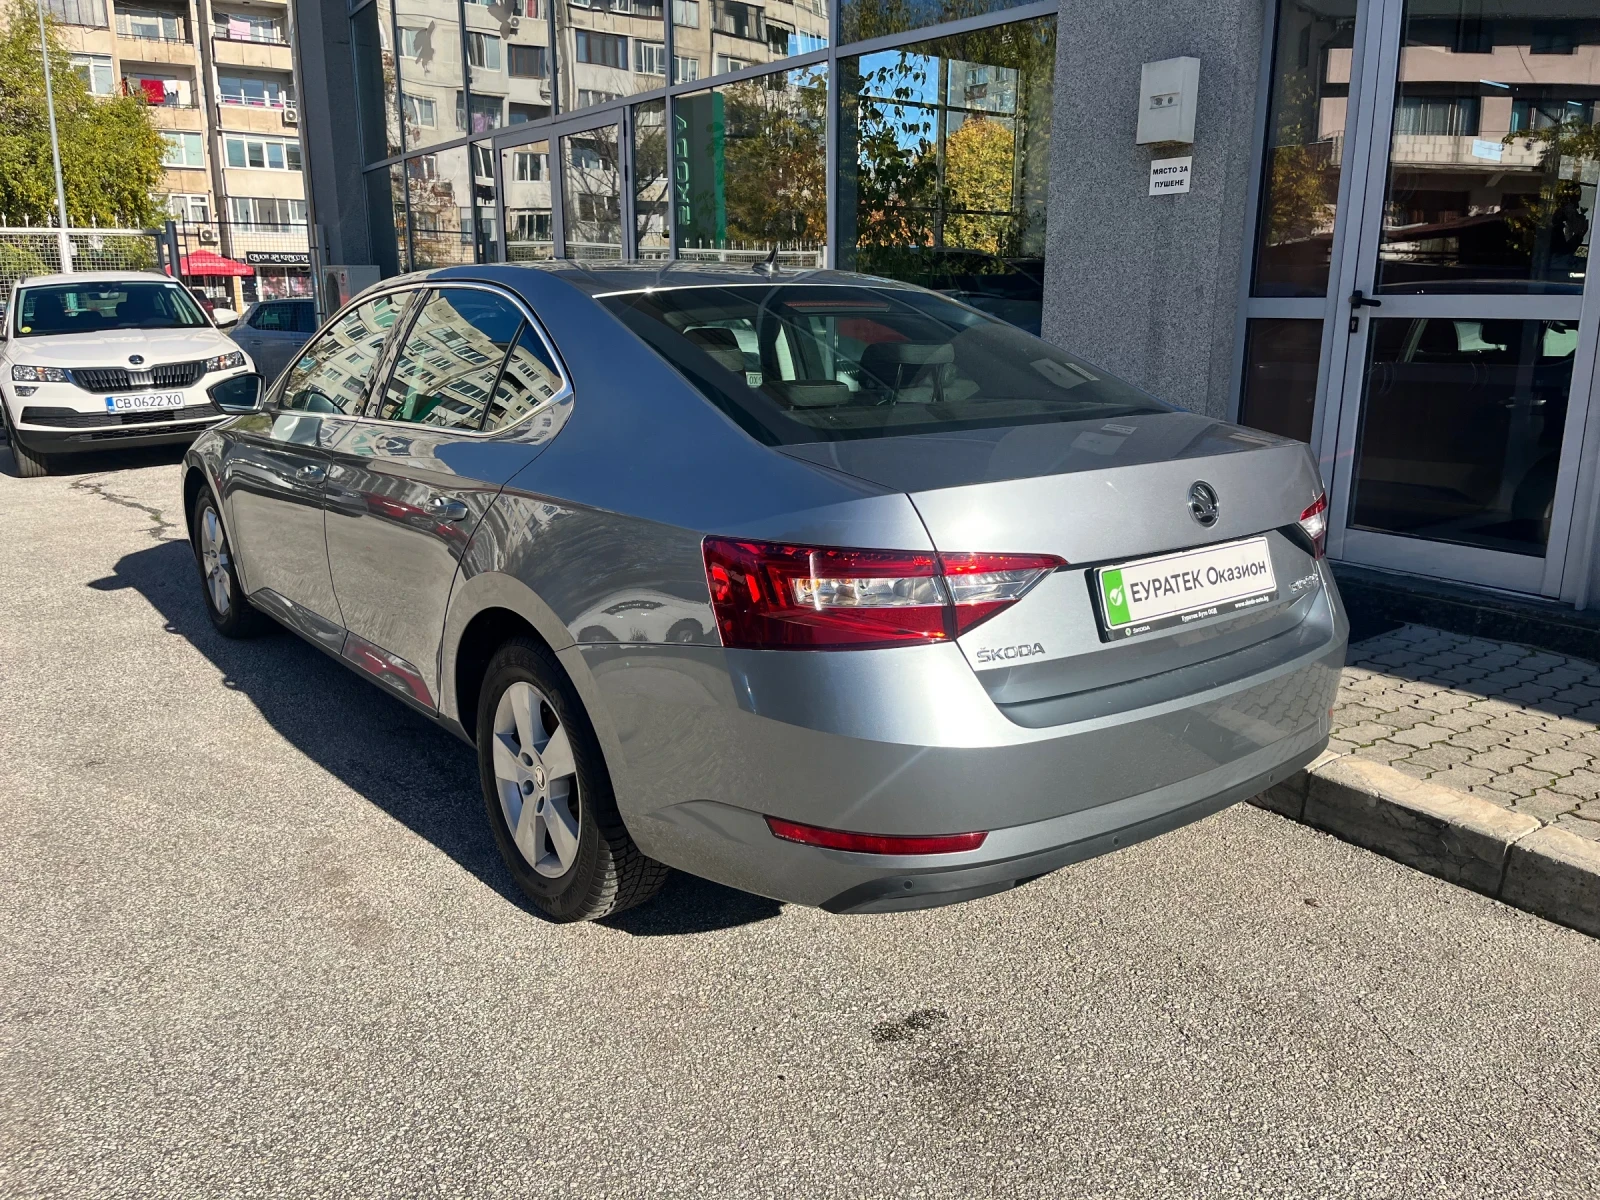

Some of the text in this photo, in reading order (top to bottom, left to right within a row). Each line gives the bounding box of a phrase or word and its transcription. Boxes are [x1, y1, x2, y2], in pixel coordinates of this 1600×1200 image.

[1153, 167, 1177, 175] МЯСТО
[1155, 179, 1184, 188] ПУШЕНЕ
[115, 398, 132, 409] CB
[134, 396, 164, 407] 0622
[1130, 569, 1204, 603] ЕУРАТЕК
[1206, 560, 1267, 586] Оказион
[976, 642, 1046, 663] ŠKODA
